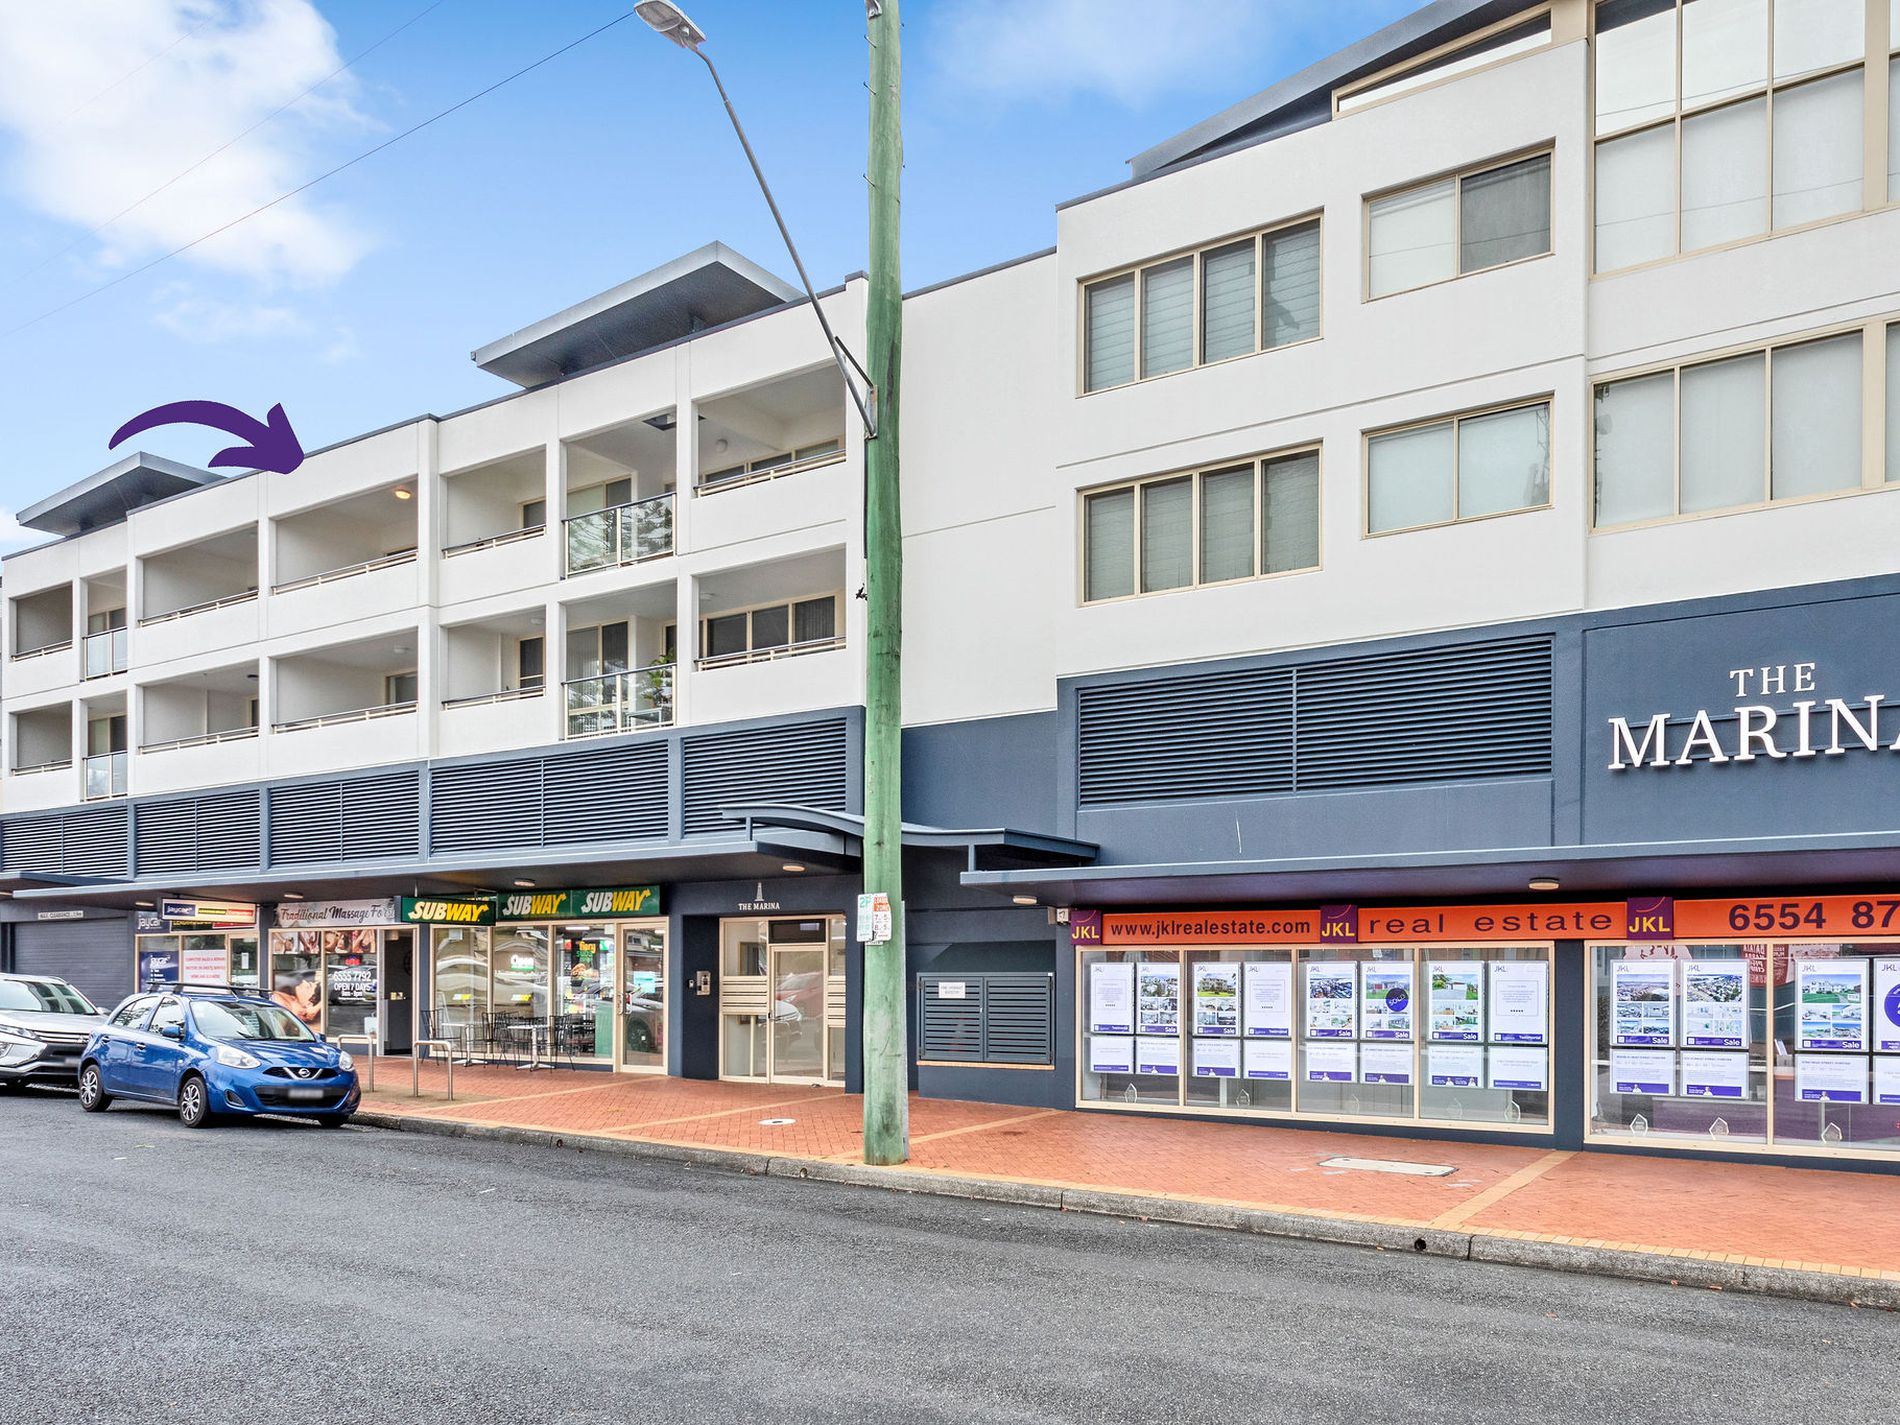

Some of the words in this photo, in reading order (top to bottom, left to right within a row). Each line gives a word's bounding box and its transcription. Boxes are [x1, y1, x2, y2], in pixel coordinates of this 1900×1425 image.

[1729, 662, 1816, 697] THE
[503, 893, 566, 915] SUBWAY
[581, 888, 651, 912] SUBWAY
[738, 902, 752, 910] THE
[753, 902, 780, 910] MARINA
[280, 908, 328, 921] Traditional
[328, 906, 369, 923] Massage
[408, 901, 489, 922] SUBWAY
[1728, 902, 1826, 931] 6554
[1851, 900, 1900, 929] 87
[1111, 919, 1310, 938] www.jklrealestate.com
[1321, 922, 1355, 937] JKL
[1369, 913, 1444, 934] real
[1474, 911, 1612, 932] estate
[1629, 916, 1670, 933] JKL
[1072, 926, 1100, 940] JKL
[1881, 963, 1898, 972] JKL
[1652, 1036, 1668, 1045] Sale
[1842, 1041, 1860, 1049] Sale
